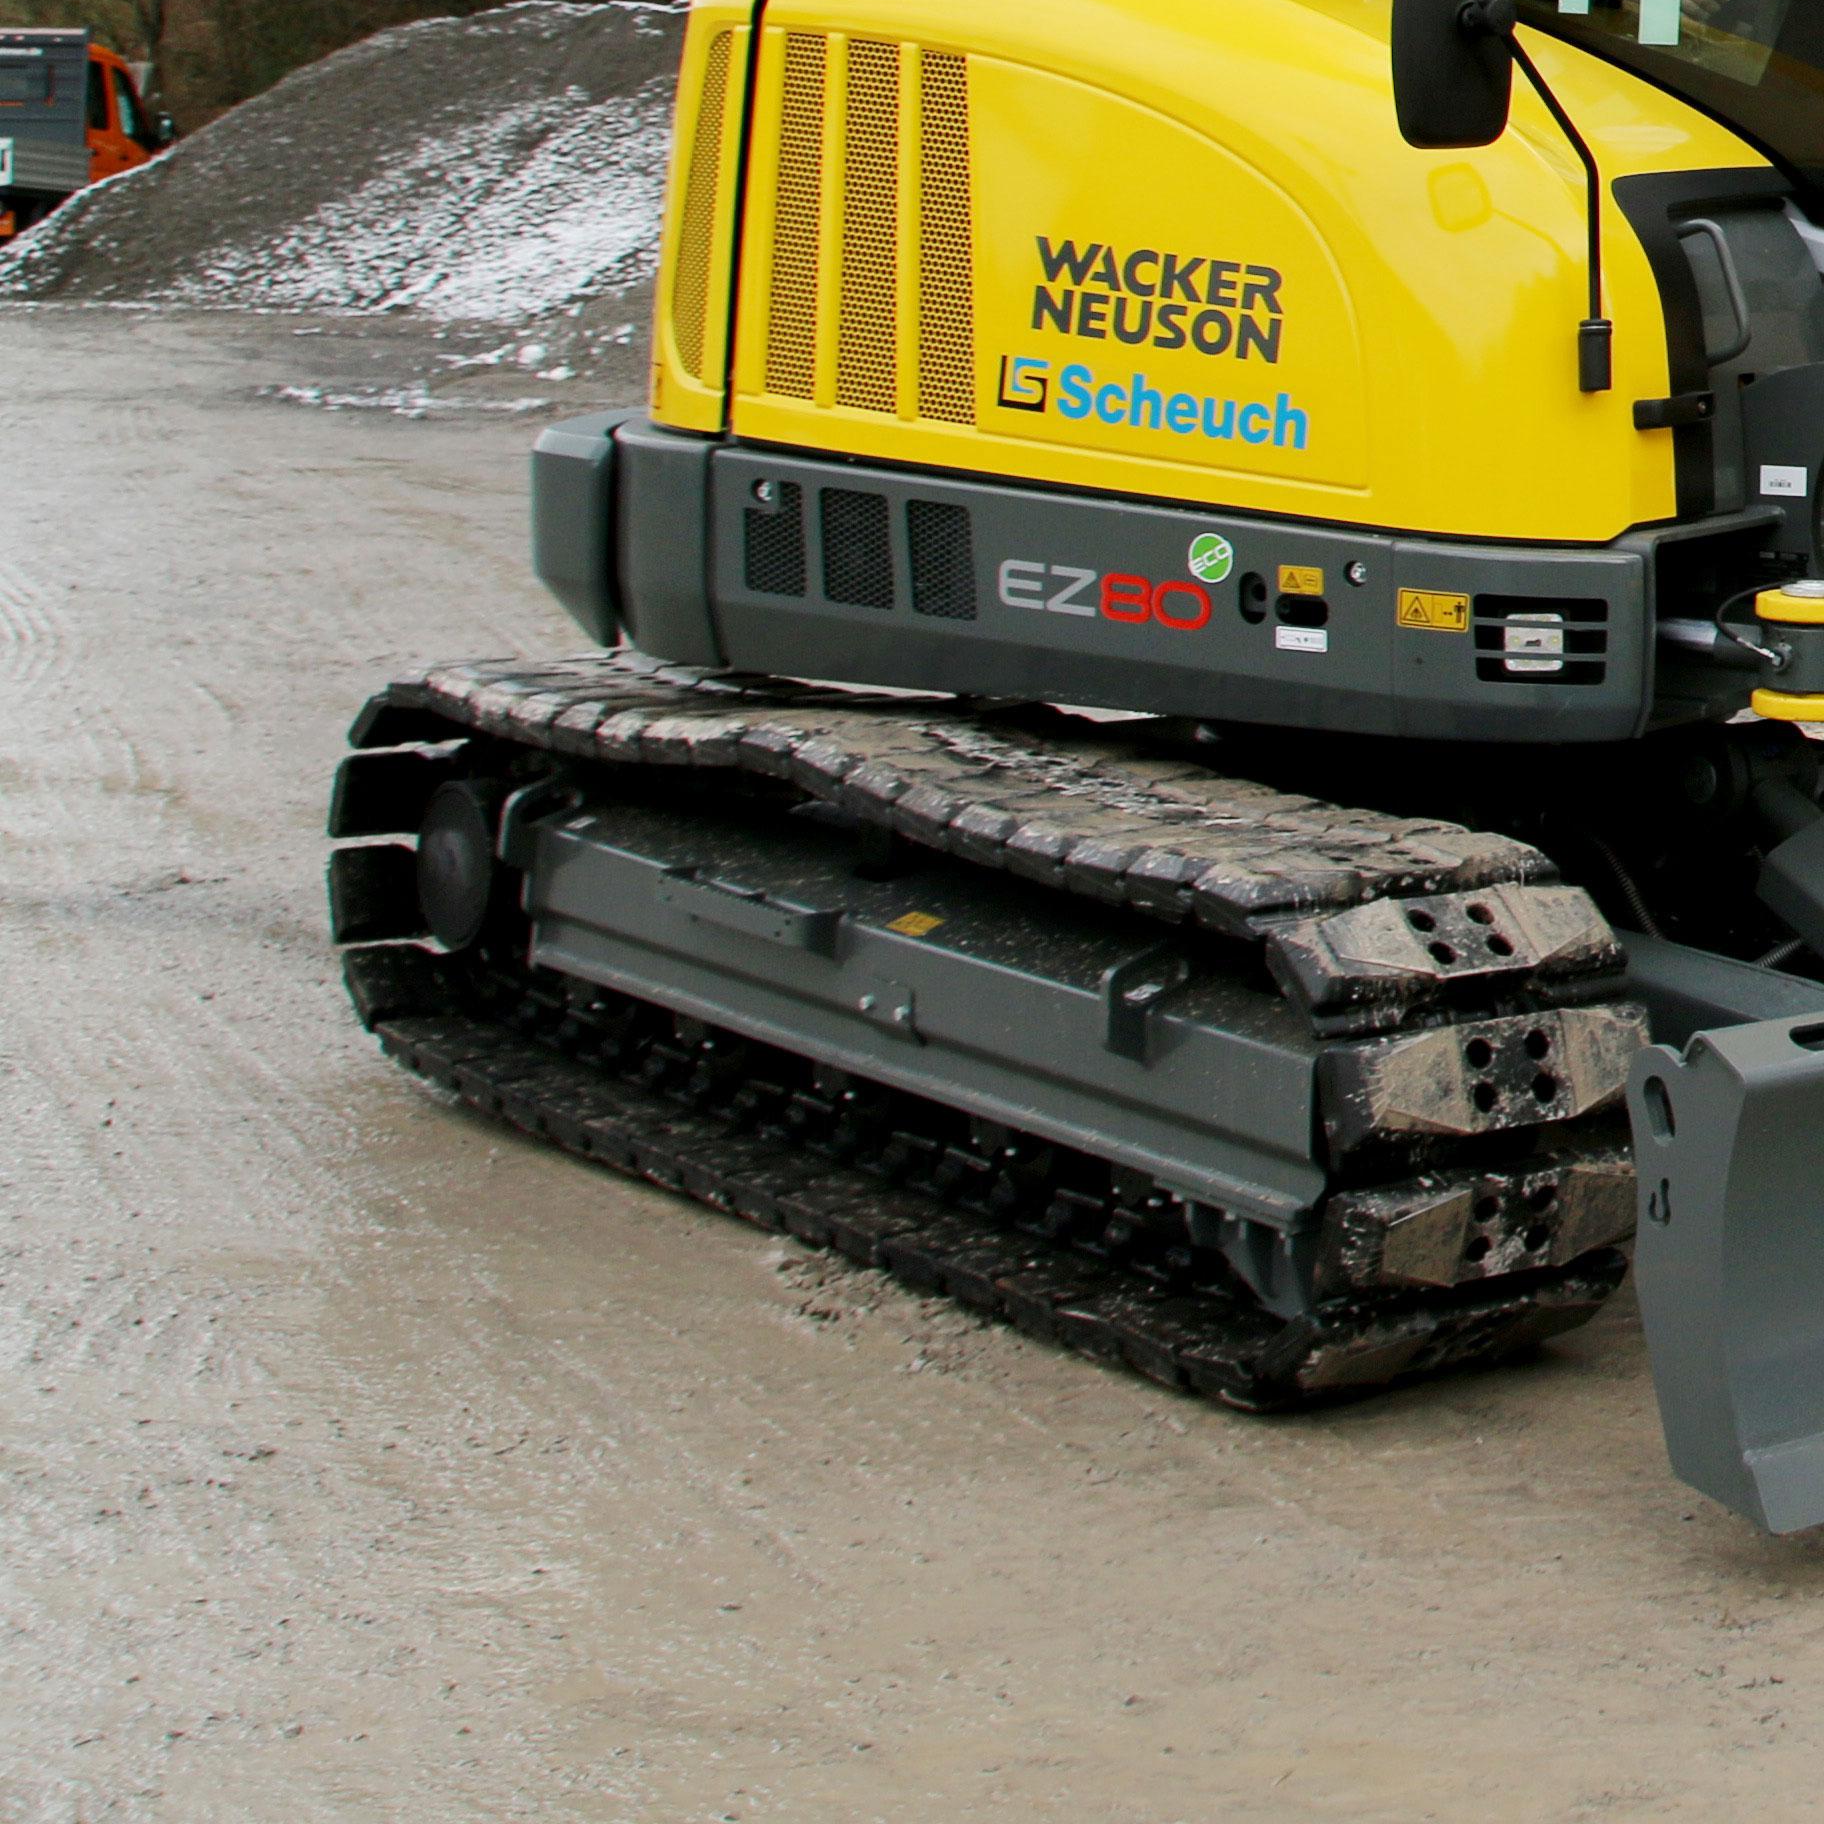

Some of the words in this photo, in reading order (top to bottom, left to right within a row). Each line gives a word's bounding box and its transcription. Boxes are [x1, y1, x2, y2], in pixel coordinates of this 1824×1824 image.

[1035, 235, 1284, 314] WACKER
[1031, 285, 1283, 364] NEUSON
[1057, 364, 1307, 450] Scheuch
[999, 559, 1212, 631] EZ80
[1188, 541, 1233, 573] ECO
